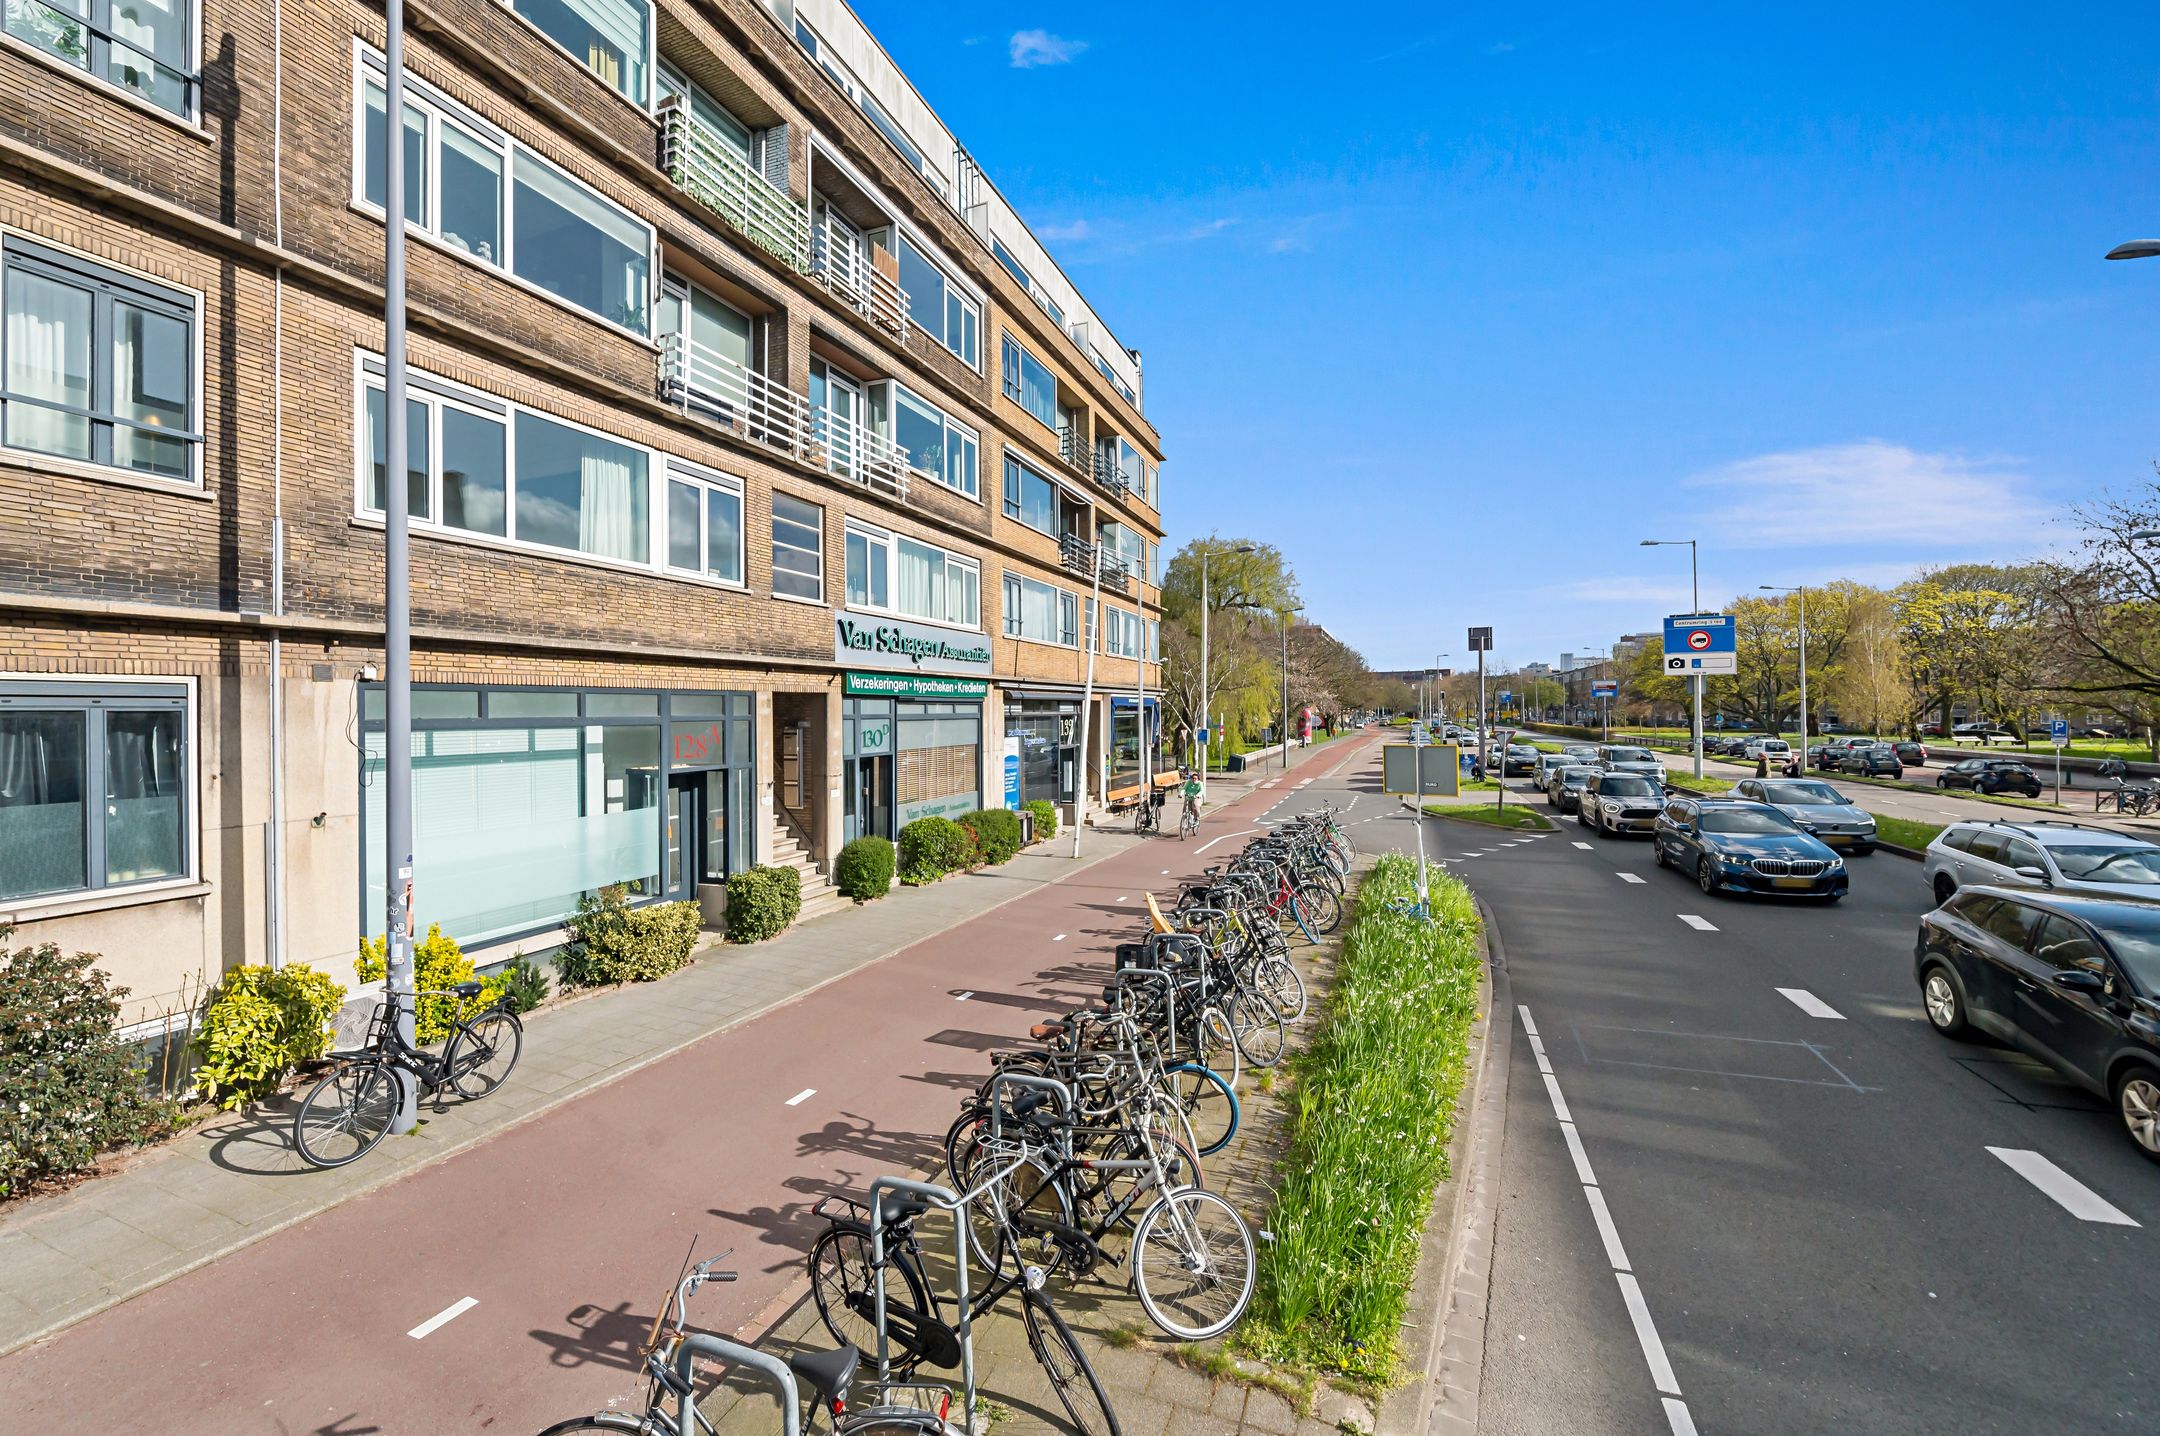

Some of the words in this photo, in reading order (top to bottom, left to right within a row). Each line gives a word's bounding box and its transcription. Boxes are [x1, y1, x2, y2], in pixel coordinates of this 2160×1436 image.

[839, 619, 874, 649] Van
[877, 625, 939, 664] Schagen
[850, 675, 908, 692] Verzekeringen
[913, 680, 954, 694] Hypotheken
[957, 682, 985, 693] Kredieten
[2055, 722, 2064, 731] P
[1105, 1187, 1142, 1228] GIANT
